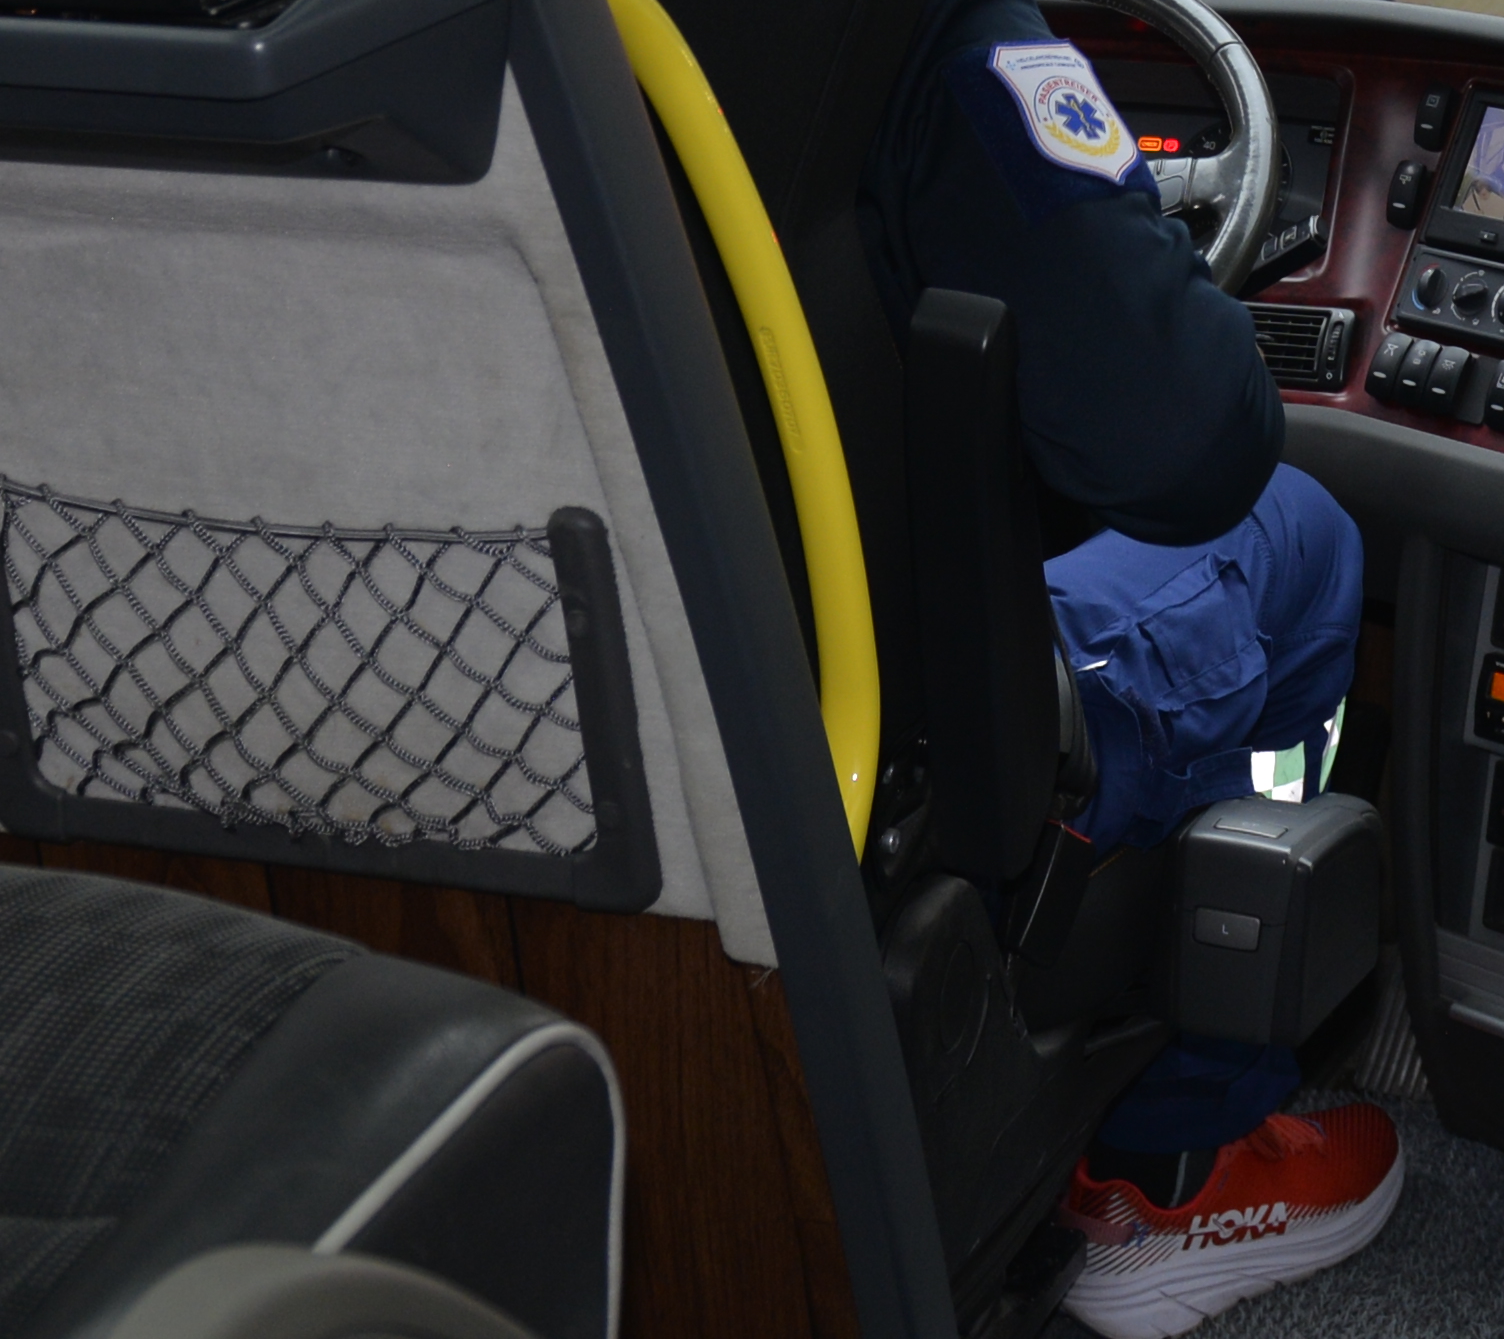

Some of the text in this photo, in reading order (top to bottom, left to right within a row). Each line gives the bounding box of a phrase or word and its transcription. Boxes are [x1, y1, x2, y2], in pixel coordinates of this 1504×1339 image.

[1038, 78, 1098, 105] PASIENTREISER
[1203, 141, 1216, 150] 40
[1182, 1200, 1288, 1251] HOKA
